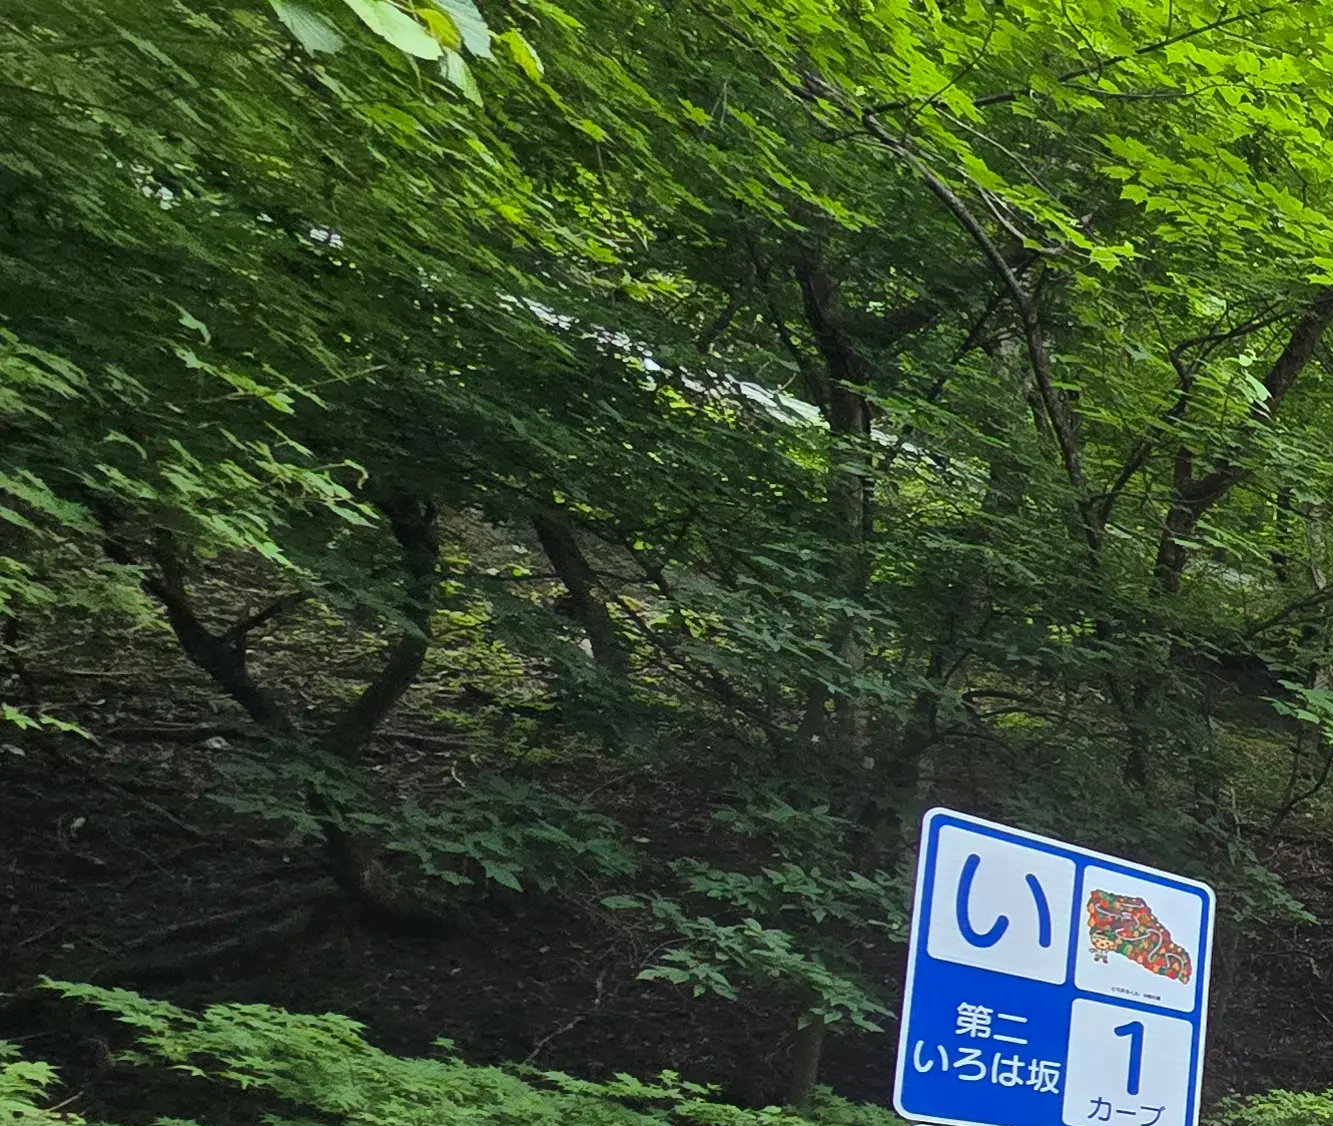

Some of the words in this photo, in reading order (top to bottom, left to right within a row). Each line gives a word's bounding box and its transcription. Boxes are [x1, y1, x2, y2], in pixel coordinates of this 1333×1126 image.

[956, 853, 1052, 949] い
[955, 1001, 1028, 1046] 第二
[912, 1039, 1062, 1095] いろは坂
[1114, 1020, 1145, 1096] 1
